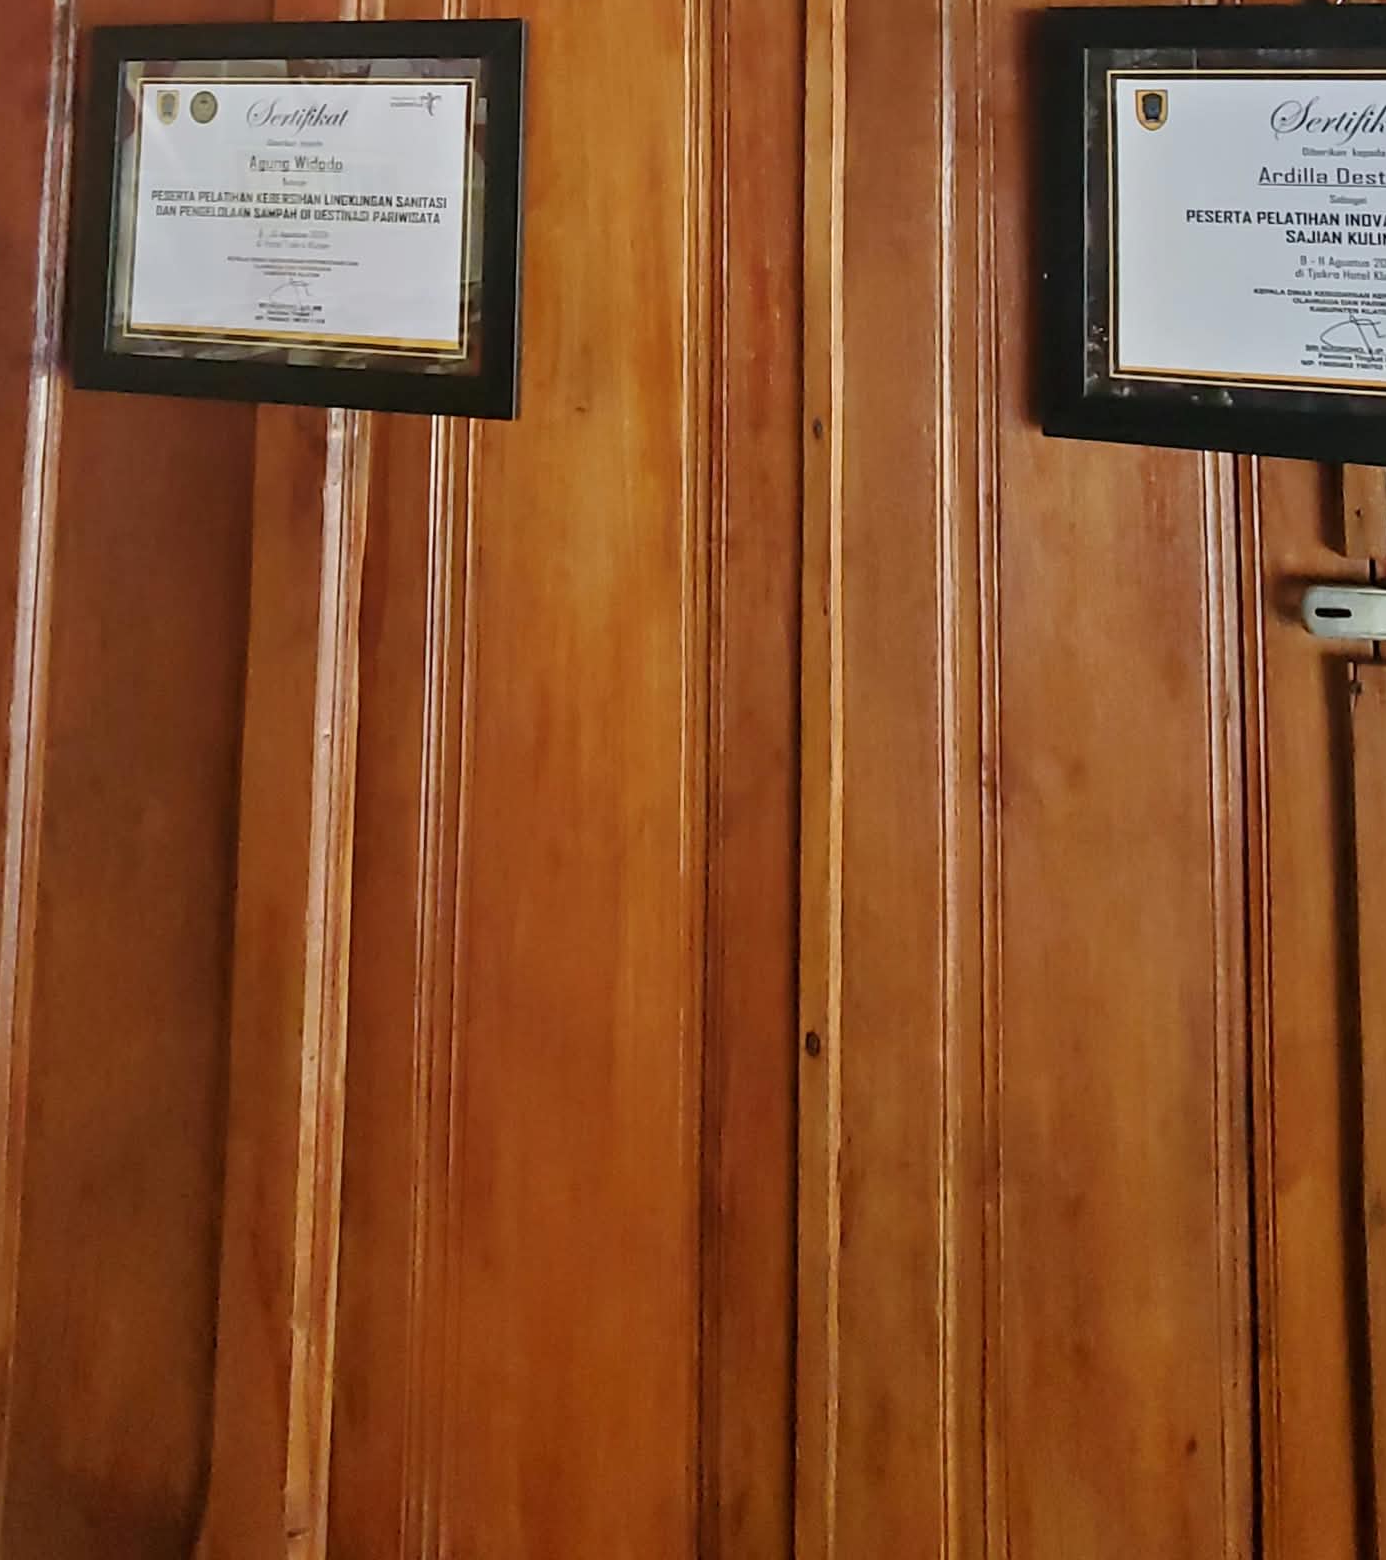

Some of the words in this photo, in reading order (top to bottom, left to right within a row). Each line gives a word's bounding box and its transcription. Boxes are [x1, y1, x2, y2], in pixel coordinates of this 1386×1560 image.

[246, 98, 349, 135] Sertifikat
[1258, 166, 1328, 185] Ardilla
[151, 190, 195, 202] PESERTA
[198, 191, 253, 203] PELATIHAN
[324, 194, 393, 207] LINGKUNGAN
[396, 196, 447, 209] SANITASI
[156, 205, 177, 216] DAN
[254, 207, 297, 219] SAMPAH
[373, 211, 441, 224] PARIWISATA
[1186, 209, 1253, 225] PESERTA
[1256, 211, 1341, 226] PELATIHAN
[1285, 229, 1343, 245] SAJIAN
